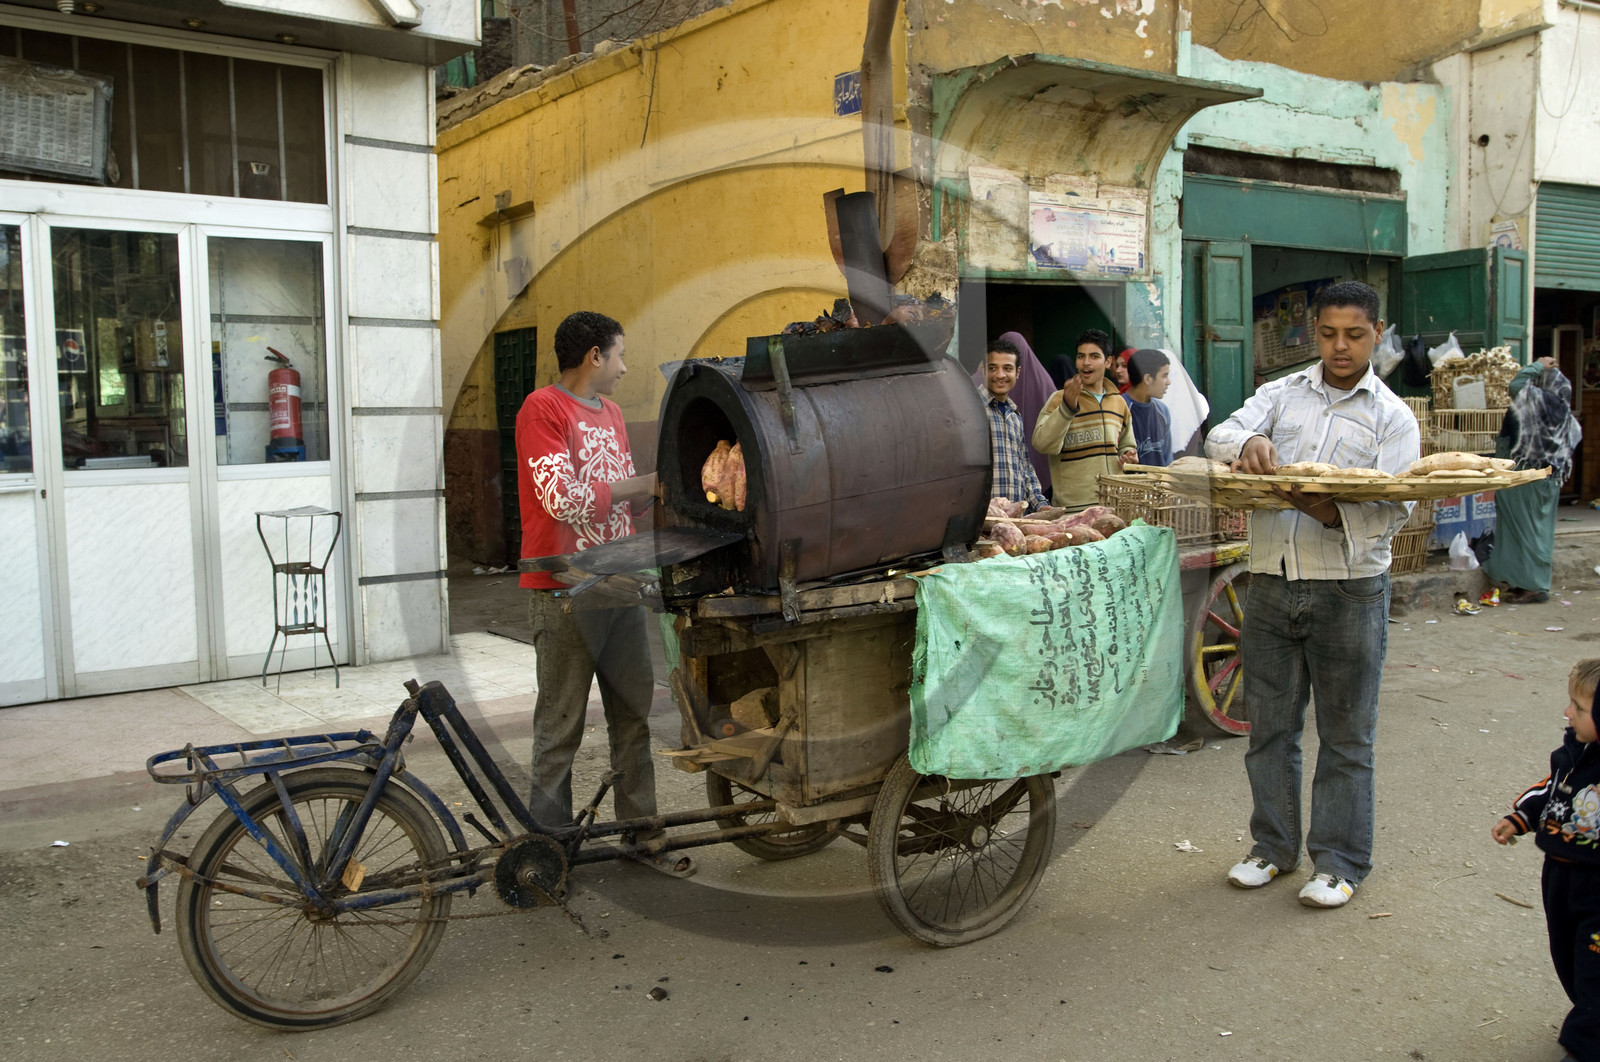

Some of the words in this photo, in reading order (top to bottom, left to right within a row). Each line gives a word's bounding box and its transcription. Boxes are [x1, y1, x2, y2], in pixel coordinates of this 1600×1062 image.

[1065, 429, 1102, 445] WEAR
[1019, 555, 1045, 586] ركة
[1058, 601, 1077, 655] القاهرة
